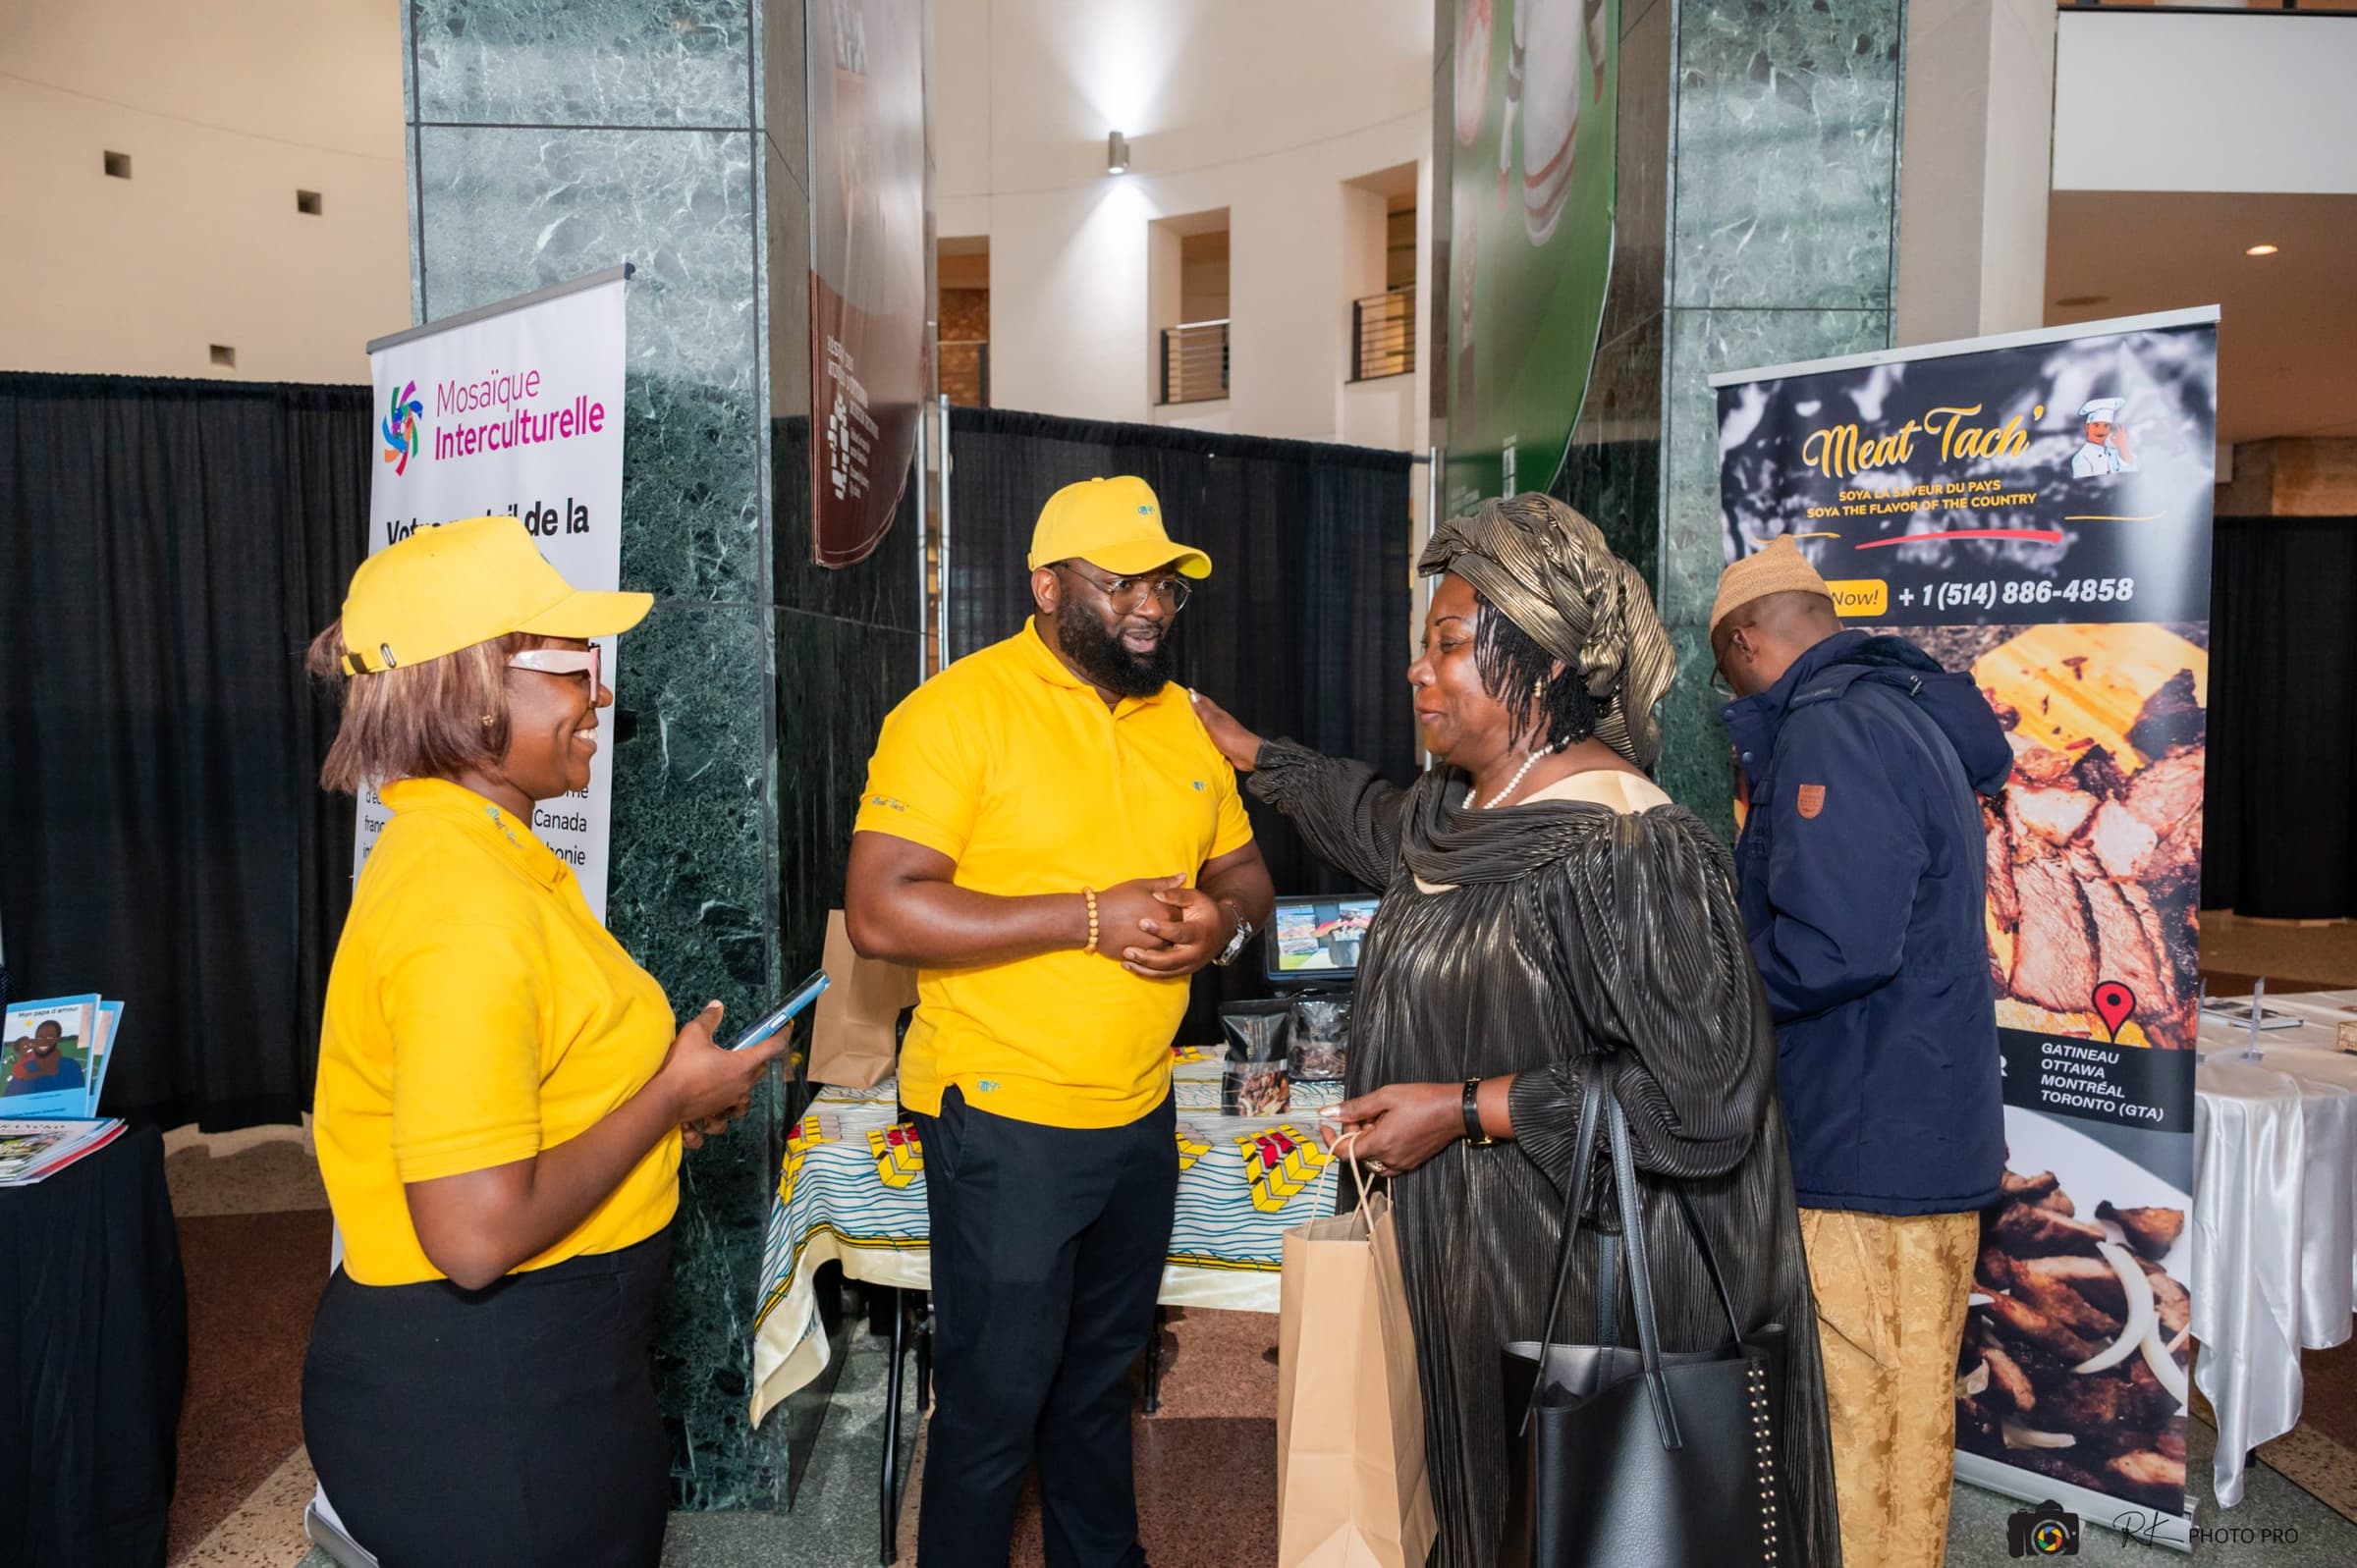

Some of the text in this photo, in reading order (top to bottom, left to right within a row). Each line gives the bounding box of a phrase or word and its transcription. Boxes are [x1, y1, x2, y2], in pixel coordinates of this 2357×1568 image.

[436, 369, 540, 417] Mosaïque
[435, 395, 605, 460] Interculturelle
[1801, 422, 1922, 478] Meat
[1838, 479, 2001, 502] SOYA LA SAVEUR DU PAYS
[524, 501, 558, 537] de
[566, 498, 589, 534] la
[1806, 493, 2037, 518] SOYA THE FLAVOR OF THE COUNTRY
[2001, 578, 2134, 605] 886-4858
[533, 809, 587, 833] Canada
[2041, 1043, 2120, 1064] GATINEAU
[2041, 1058, 2106, 1079] OTTAWA
[2041, 1074, 2126, 1099] MONTRÉAL
[2041, 1090, 2165, 1121] TORONTO (GTA)
